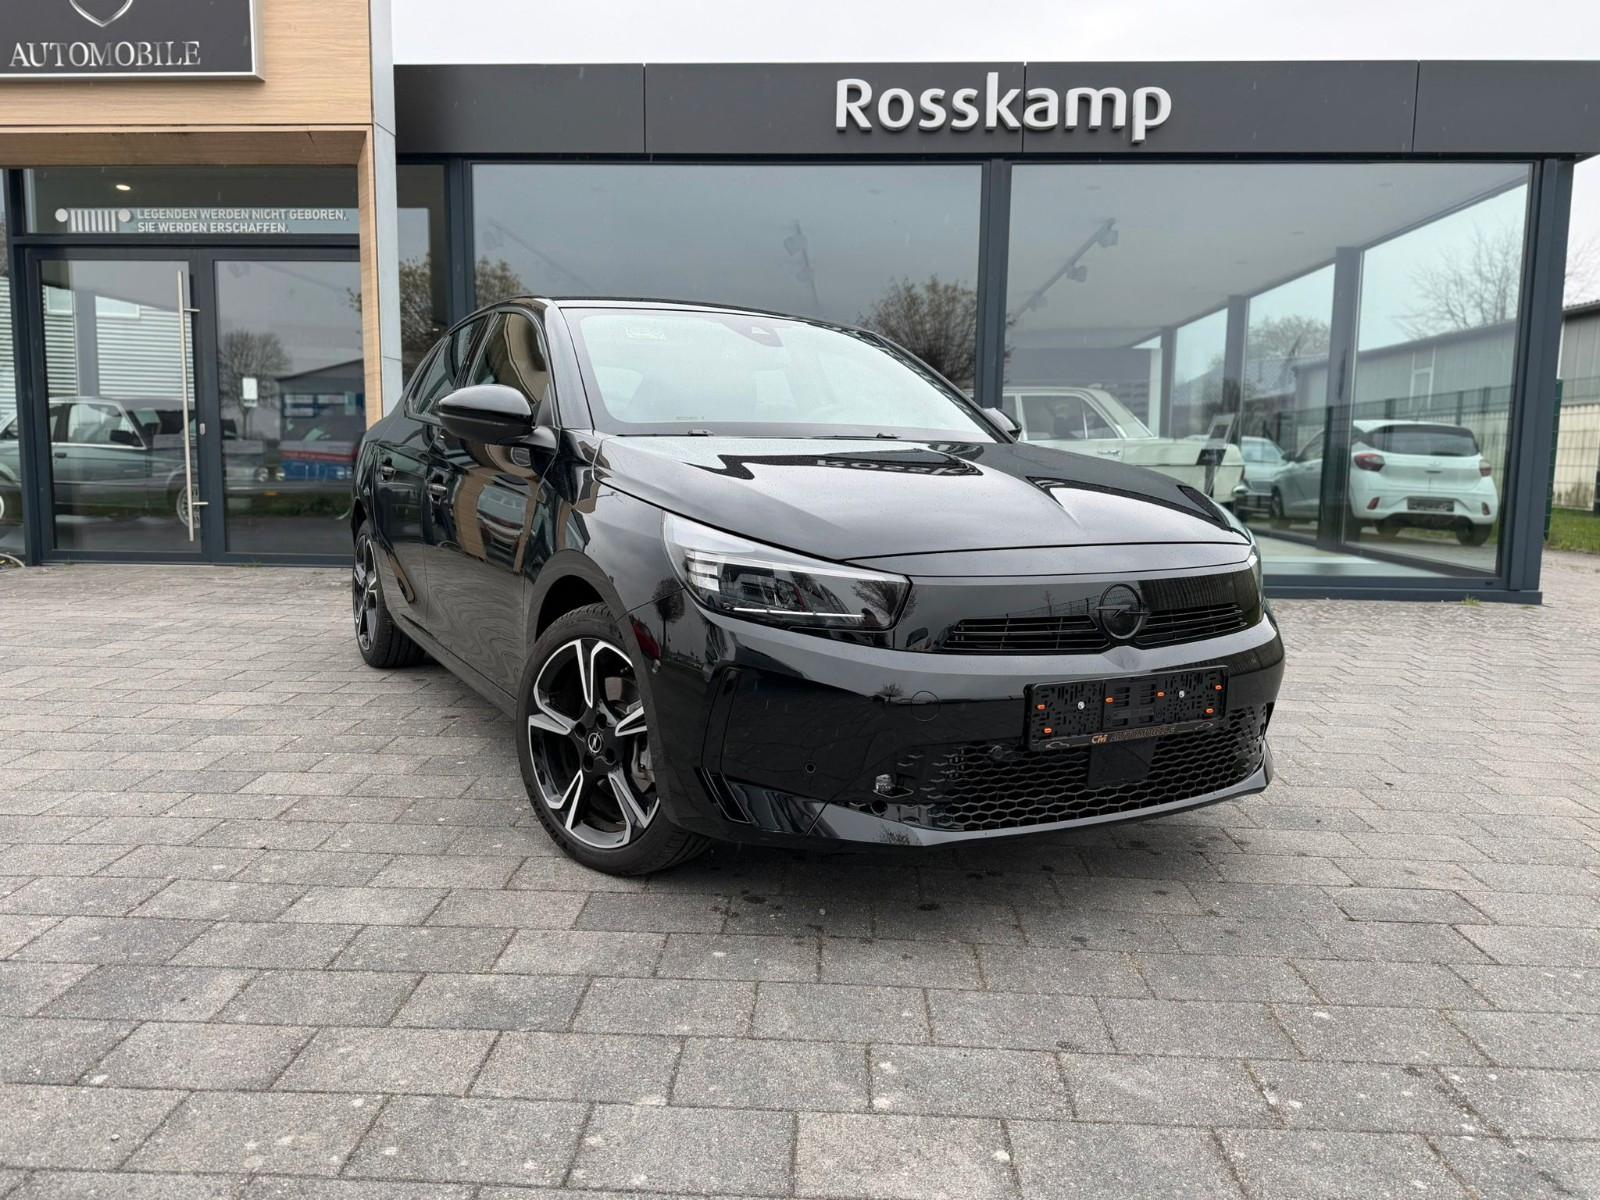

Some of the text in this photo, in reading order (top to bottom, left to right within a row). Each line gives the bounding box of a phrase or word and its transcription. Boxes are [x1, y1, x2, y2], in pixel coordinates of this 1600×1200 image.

[9, 41, 201, 67] AUTOMOBILE
[835, 71, 1172, 144] Rosskamp
[137, 208, 198, 219] LEGENDEN
[200, 208, 249, 219] WERDEN
[252, 208, 287, 219] NICHT
[138, 222, 289, 234] SIE WERDEN ERSCHAFFEN.
